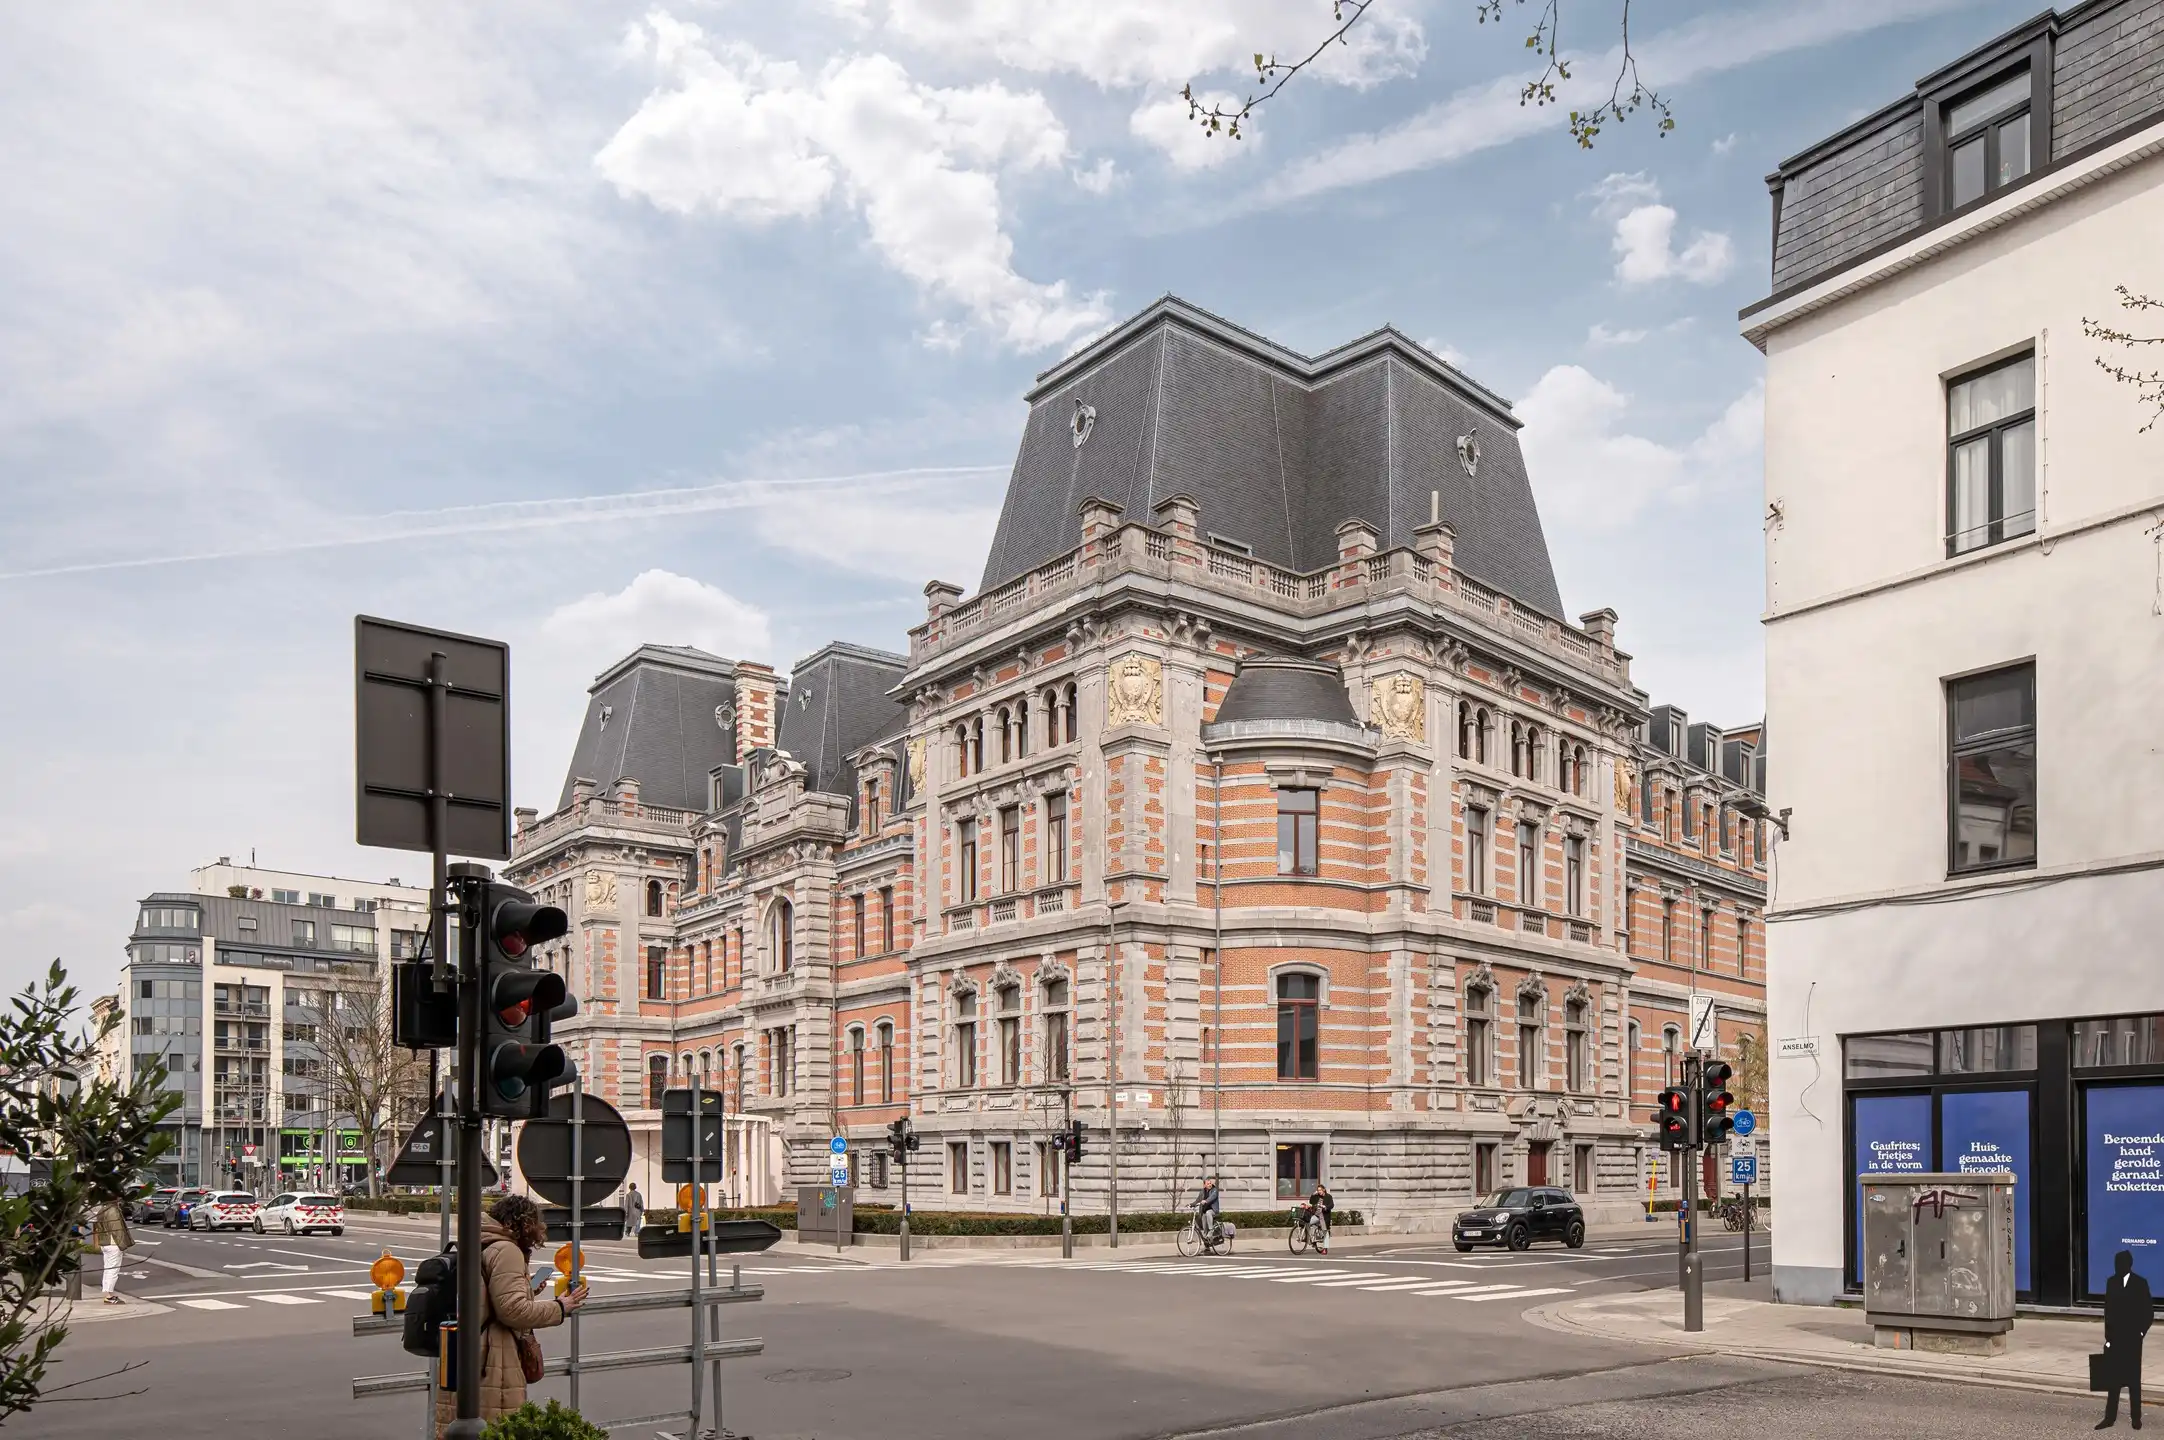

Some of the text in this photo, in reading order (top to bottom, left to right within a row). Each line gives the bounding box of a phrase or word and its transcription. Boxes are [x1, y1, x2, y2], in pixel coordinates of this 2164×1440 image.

[1870, 1141, 1921, 1151] Gaufrites;
[1971, 1142, 2000, 1152] Huis-
[2120, 1145, 2156, 1156] hand-
[1877, 1150, 1913, 1161] frietjes
[1959, 1153, 2013, 1165] gemaakte
[1737, 1161, 1751, 1172] 25
[1869, 1160, 1879, 1169] in
[1881, 1160, 1893, 1169] de
[2114, 1157, 2161, 1169] gerolde
[835, 1170, 845, 1178] 25
[2112, 1169, 2163, 1181] garnaal-
[2106, 1181, 2164, 1191] kroketten
